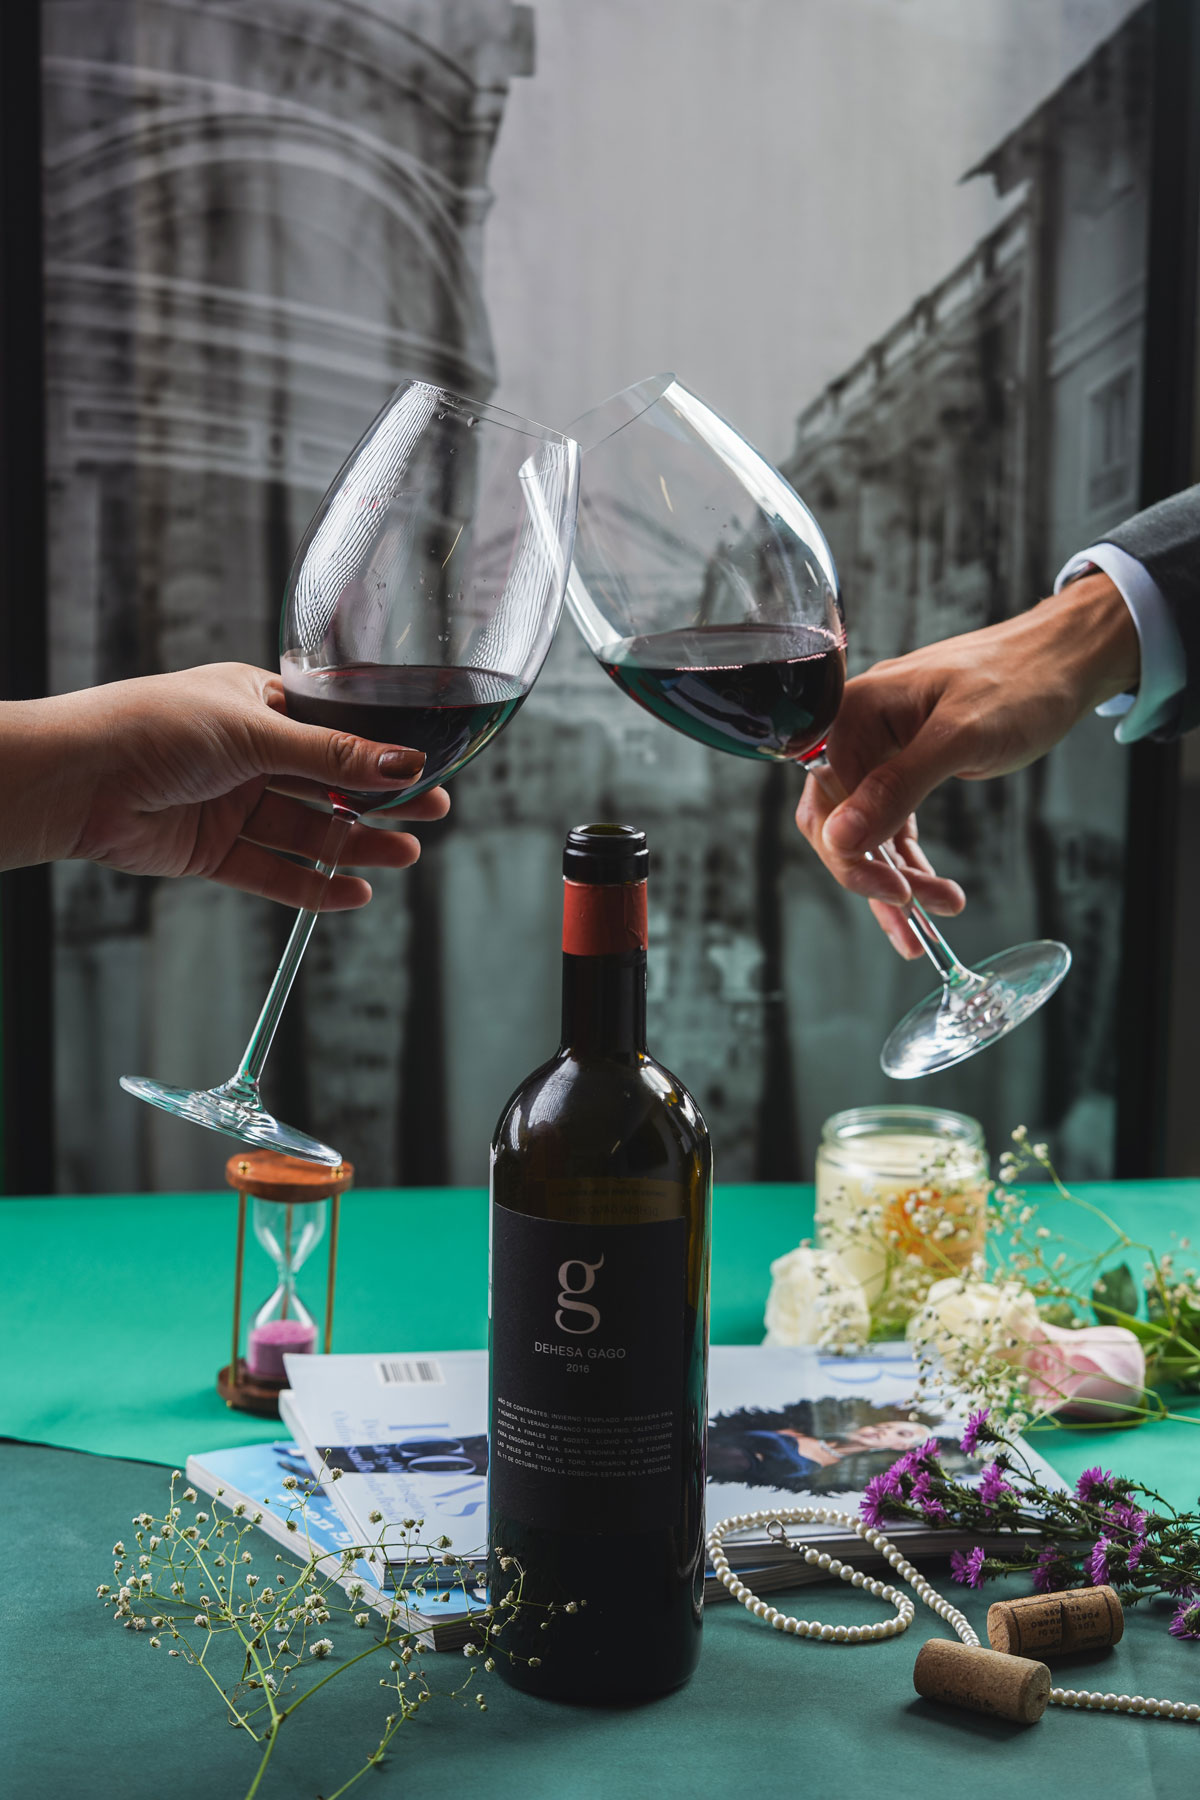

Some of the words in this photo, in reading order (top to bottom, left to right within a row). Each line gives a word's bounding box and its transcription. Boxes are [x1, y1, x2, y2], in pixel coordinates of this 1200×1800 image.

[554, 1252, 605, 1334] g
[534, 1341, 583, 1358] DEHESA
[587, 1348, 626, 1359] GAGO
[566, 1363, 590, 1374] 2016
[527, 1419, 550, 1429] VERANO
[661, 1420, 673, 1429] CON
[550, 1413, 582, 1422] INVIERNO
[623, 1413, 660, 1422] PRIMAVERA
[497, 1419, 515, 1431] JUSTICIA
[524, 1428, 546, 1439] FINALES
[637, 1431, 673, 1444] SEPTIEMBRE
[497, 1440, 505, 1448] LAS
[506, 1444, 522, 1454] PIELES
[524, 1450, 532, 1458] DE
[535, 1453, 552, 1462] TINTA
[568, 1458, 586, 1466] TORO
[508, 1434, 535, 1447] ENGORDAR
[630, 1447, 644, 1455] DOS
[507, 1455, 514, 1463] DE
[514, 1458, 539, 1470] OCTUBRE
[540, 1465, 556, 1473] TODA
